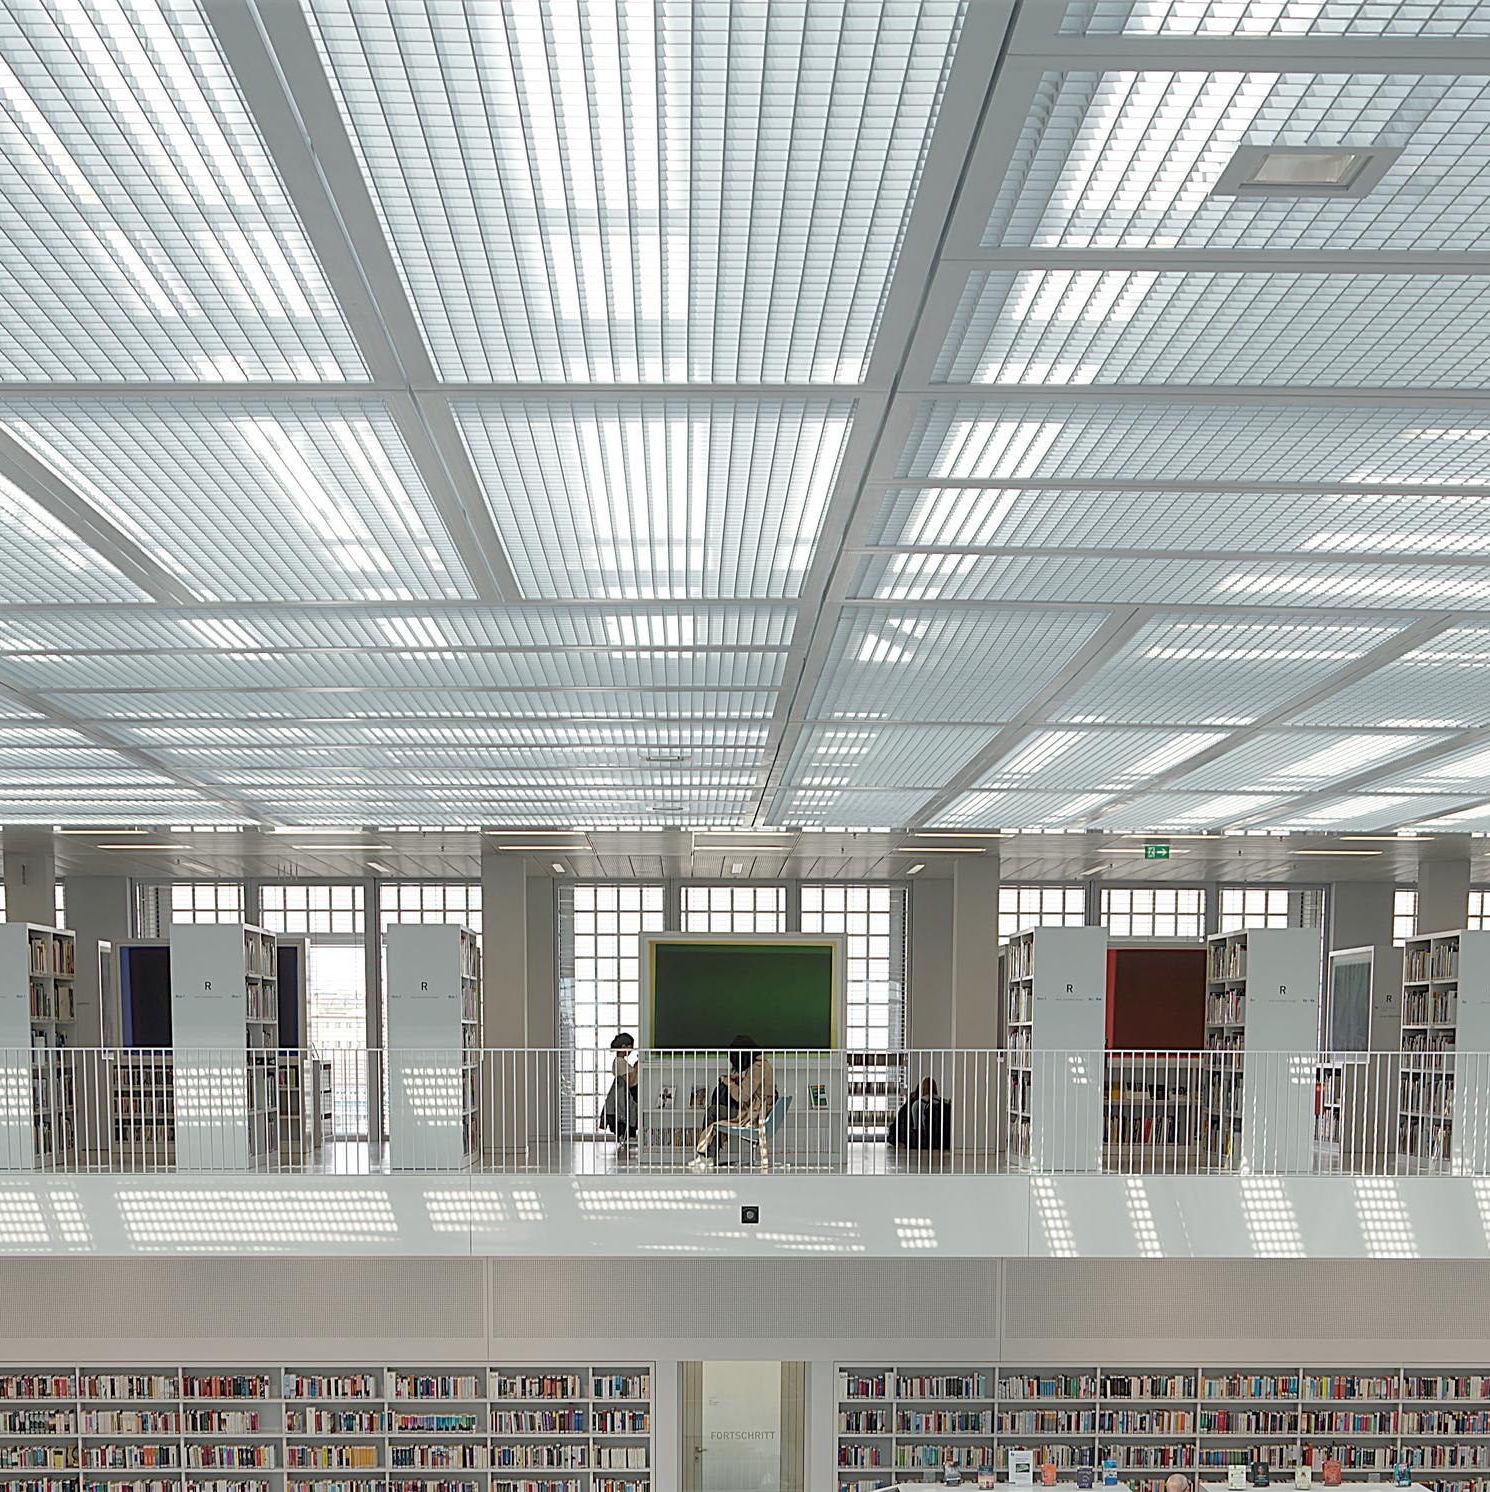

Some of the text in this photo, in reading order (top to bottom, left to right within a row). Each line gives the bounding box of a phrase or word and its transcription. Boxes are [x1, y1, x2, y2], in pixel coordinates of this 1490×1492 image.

[204, 981, 212, 991] R
[421, 981, 428, 991] R
[1066, 983, 1073, 993] R
[1279, 985, 1287, 995] R
[1385, 994, 1392, 1003] R
[710, 1431, 775, 1440] FORTSCHRITT
